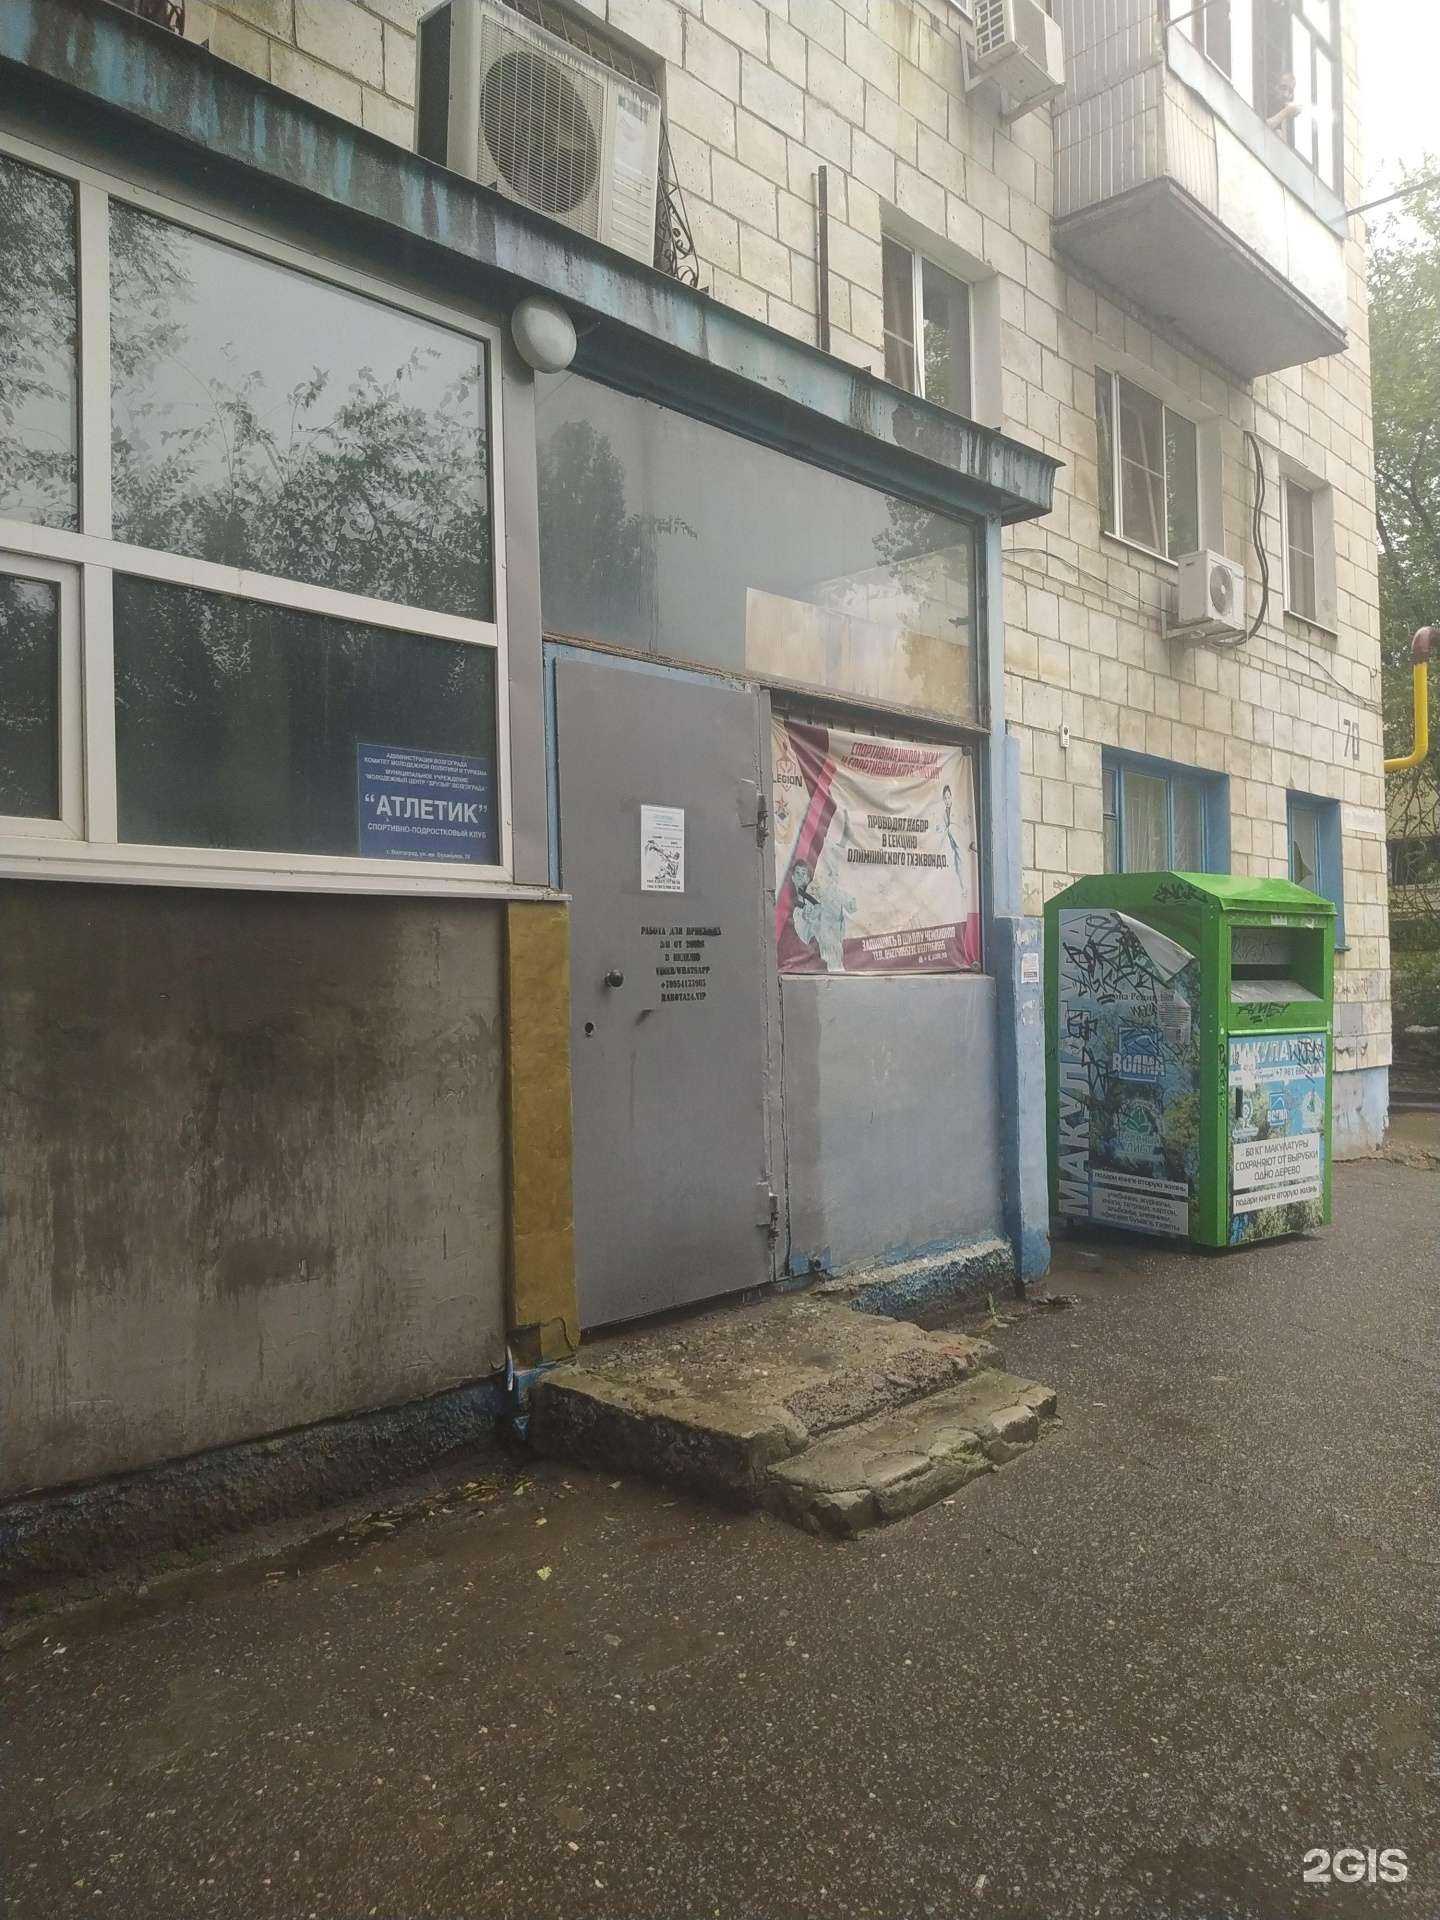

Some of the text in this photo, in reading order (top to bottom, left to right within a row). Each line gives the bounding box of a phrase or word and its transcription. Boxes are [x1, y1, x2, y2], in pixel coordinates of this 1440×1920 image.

[367, 822, 487, 839] СПОРТИВНО-ПОДРОСТКОВЫЙ КЛУБ
[867, 815, 929, 832] ПРОВОДЯТ НАБОР
[882, 834, 918, 849] В СЕКЦИЮ
[847, 848, 905, 866] ОЛИМПИЙСКОГО
[641, 926, 666, 935] РАБОТА
[1264, 1139, 1309, 1154] МАКУЛАТУРЫ
[1235, 1150, 1319, 1172] СОХРАНЯЮТ ОТ ВЫРУБКИ
[1254, 1168, 1274, 1181] ОДНО
[1275, 1164, 1301, 1178] ДЕРЕВО
